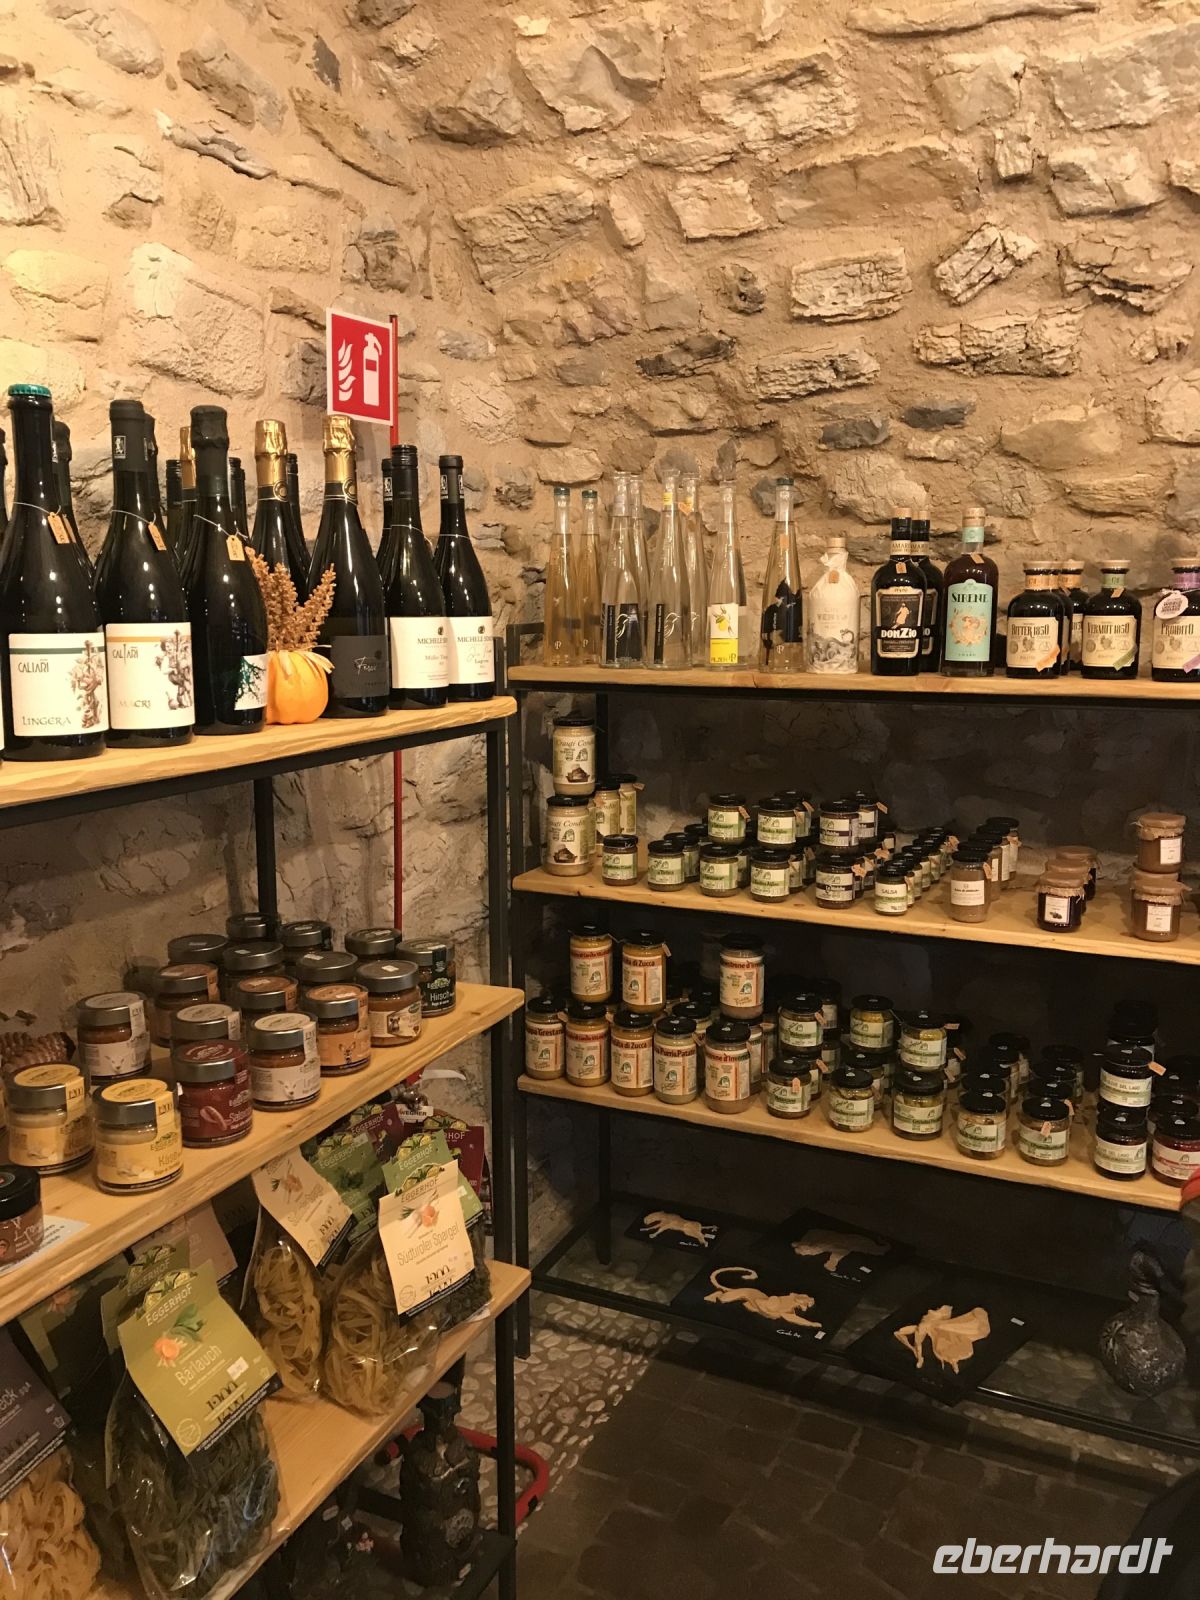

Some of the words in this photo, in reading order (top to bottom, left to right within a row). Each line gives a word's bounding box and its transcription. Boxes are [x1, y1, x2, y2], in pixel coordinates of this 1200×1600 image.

[951, 592, 988, 602] SIRENE
[119, 699, 151, 709] MCRI
[351, 1112, 385, 1134] EGGERHOF
[399, 1143, 433, 1171] EGGERHOF
[401, 1177, 440, 1203] EGGERHOF
[432, 1222, 460, 1248] Spargel
[146, 1284, 193, 1326] EGGERHOF
[174, 1344, 223, 1387] Bärlauch
